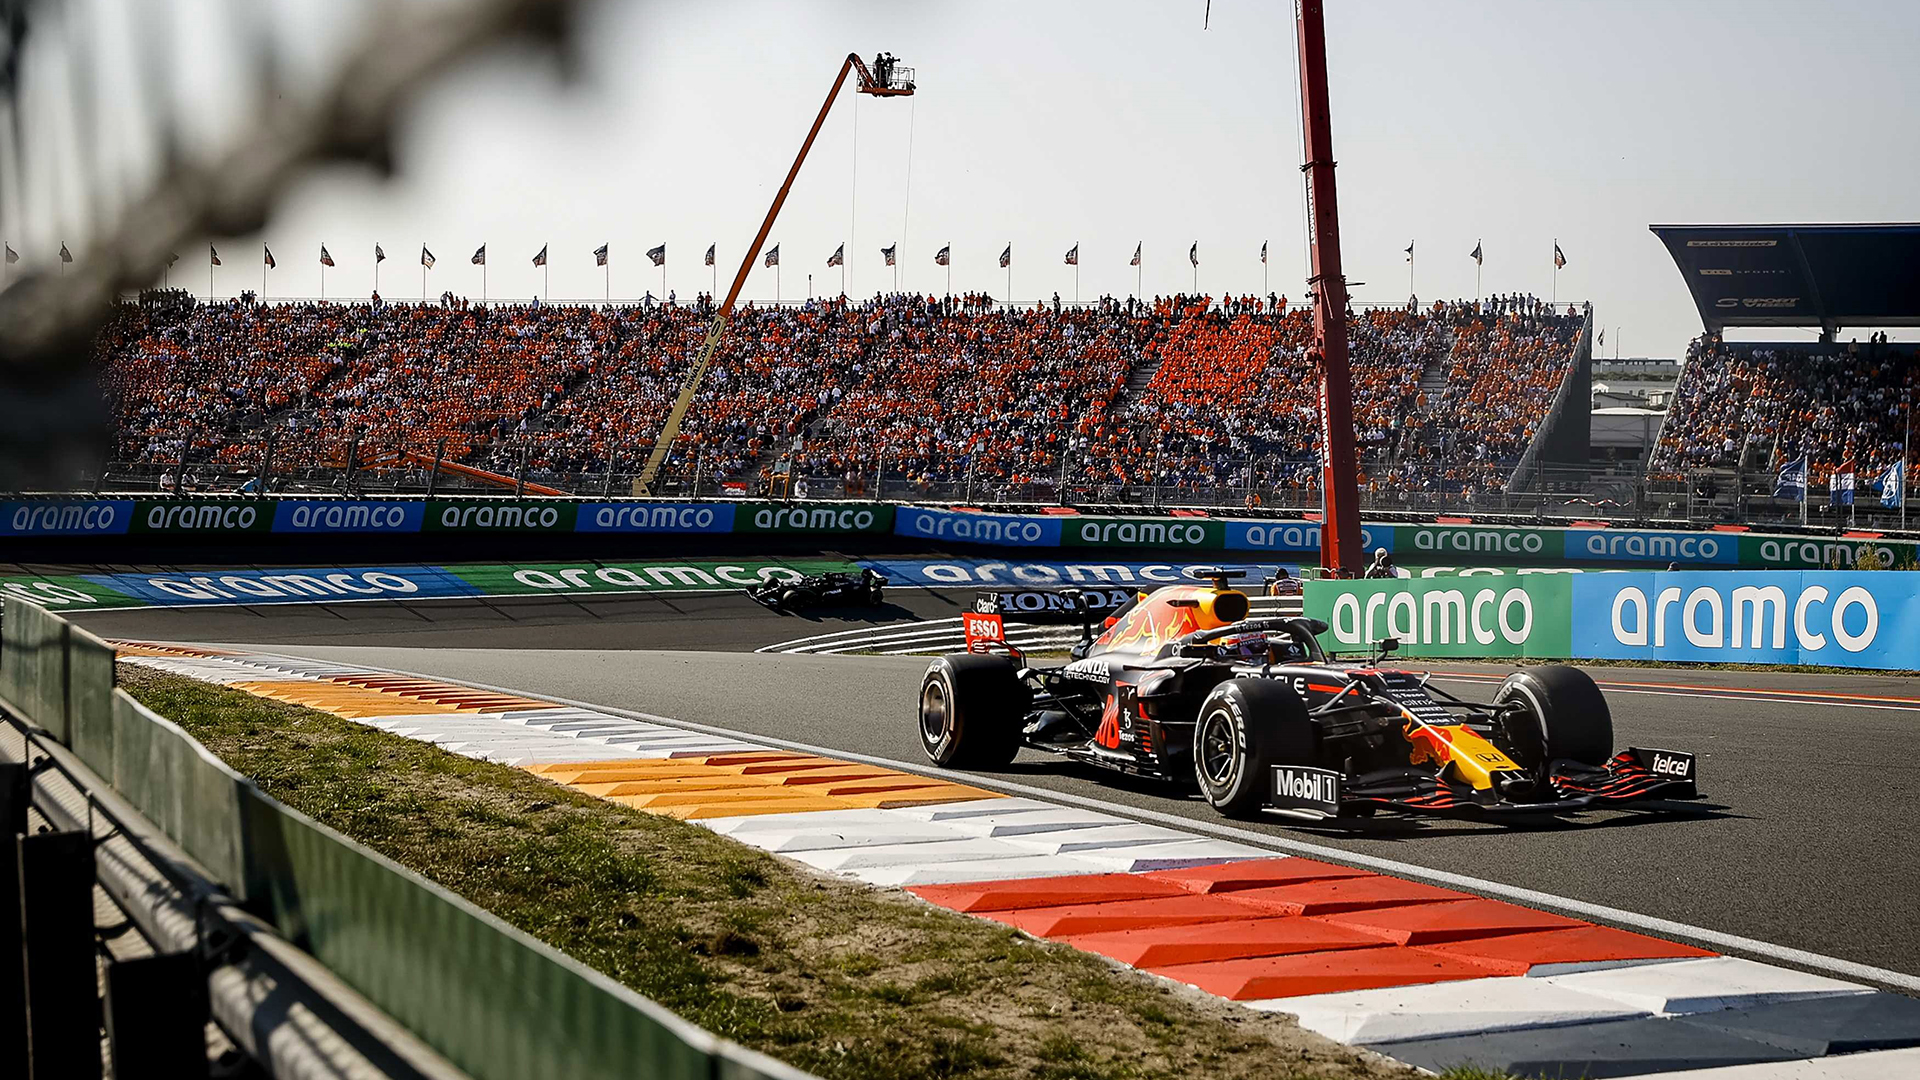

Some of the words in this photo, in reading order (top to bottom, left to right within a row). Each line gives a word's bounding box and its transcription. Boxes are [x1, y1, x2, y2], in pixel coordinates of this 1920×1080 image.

[686, 343, 711, 390] RIWAL.COM
[1320, 396, 1331, 468] MAMMOET
[12, 505, 114, 530] aramco
[147, 505, 257, 529] aramco
[292, 505, 405, 528] aramco
[441, 506, 558, 528] aramco
[596, 507, 714, 528] aramco
[754, 508, 874, 529] aramco
[915, 514, 1042, 542] aramco
[1081, 522, 1205, 544] aramco
[1246, 525, 1372, 549] aramo
[1414, 530, 1543, 553] aramco
[1587, 535, 1718, 558] aramco
[513, 565, 804, 589] aramco
[921, 563, 1223, 583] aramco
[148, 572, 418, 600] aramco
[1001, 589, 1132, 611] HONDA
[1332, 588, 1534, 645] aramco
[1611, 585, 1880, 653] aramco
[1118, 729, 1135, 742] Tezos
[1652, 753, 1691, 777] telcel
[1276, 769, 1322, 801] Mobil
